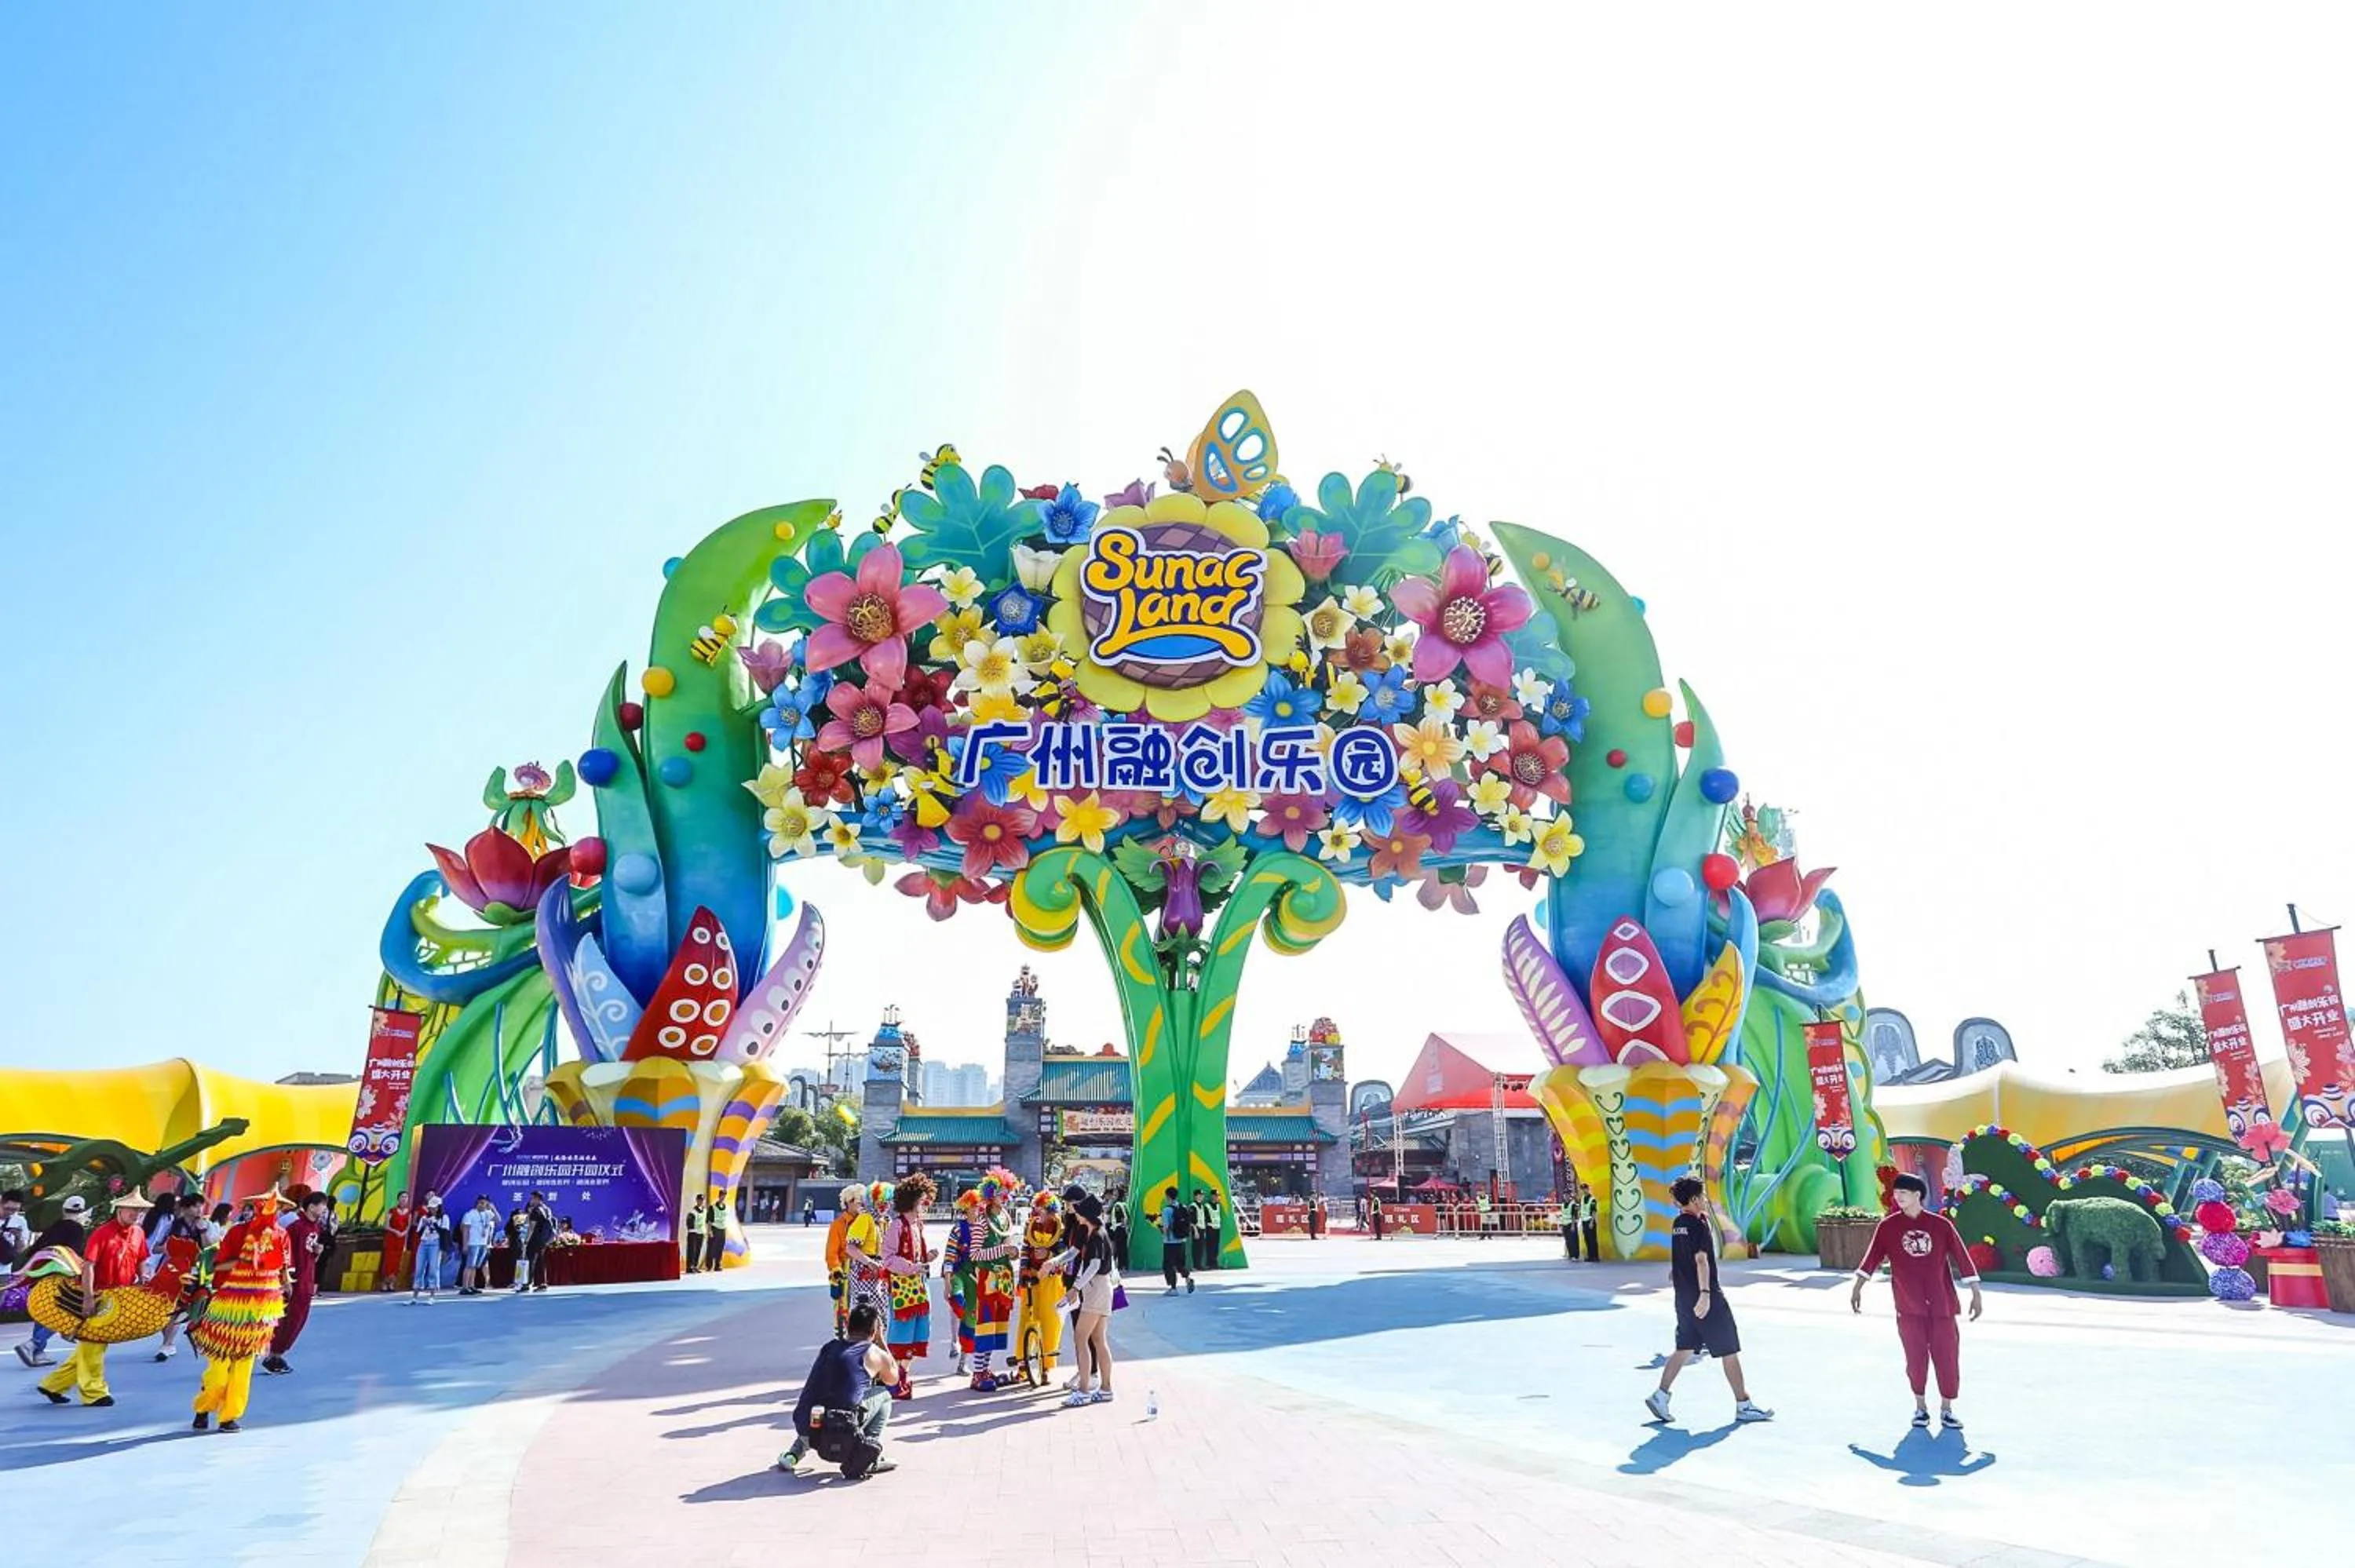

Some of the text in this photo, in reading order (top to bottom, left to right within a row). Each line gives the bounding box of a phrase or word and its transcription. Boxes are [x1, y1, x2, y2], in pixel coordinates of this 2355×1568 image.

[1091, 532, 1262, 593] Sunac
[1093, 587, 1253, 659] Land
[962, 722, 1399, 795] 广州融创乐园
